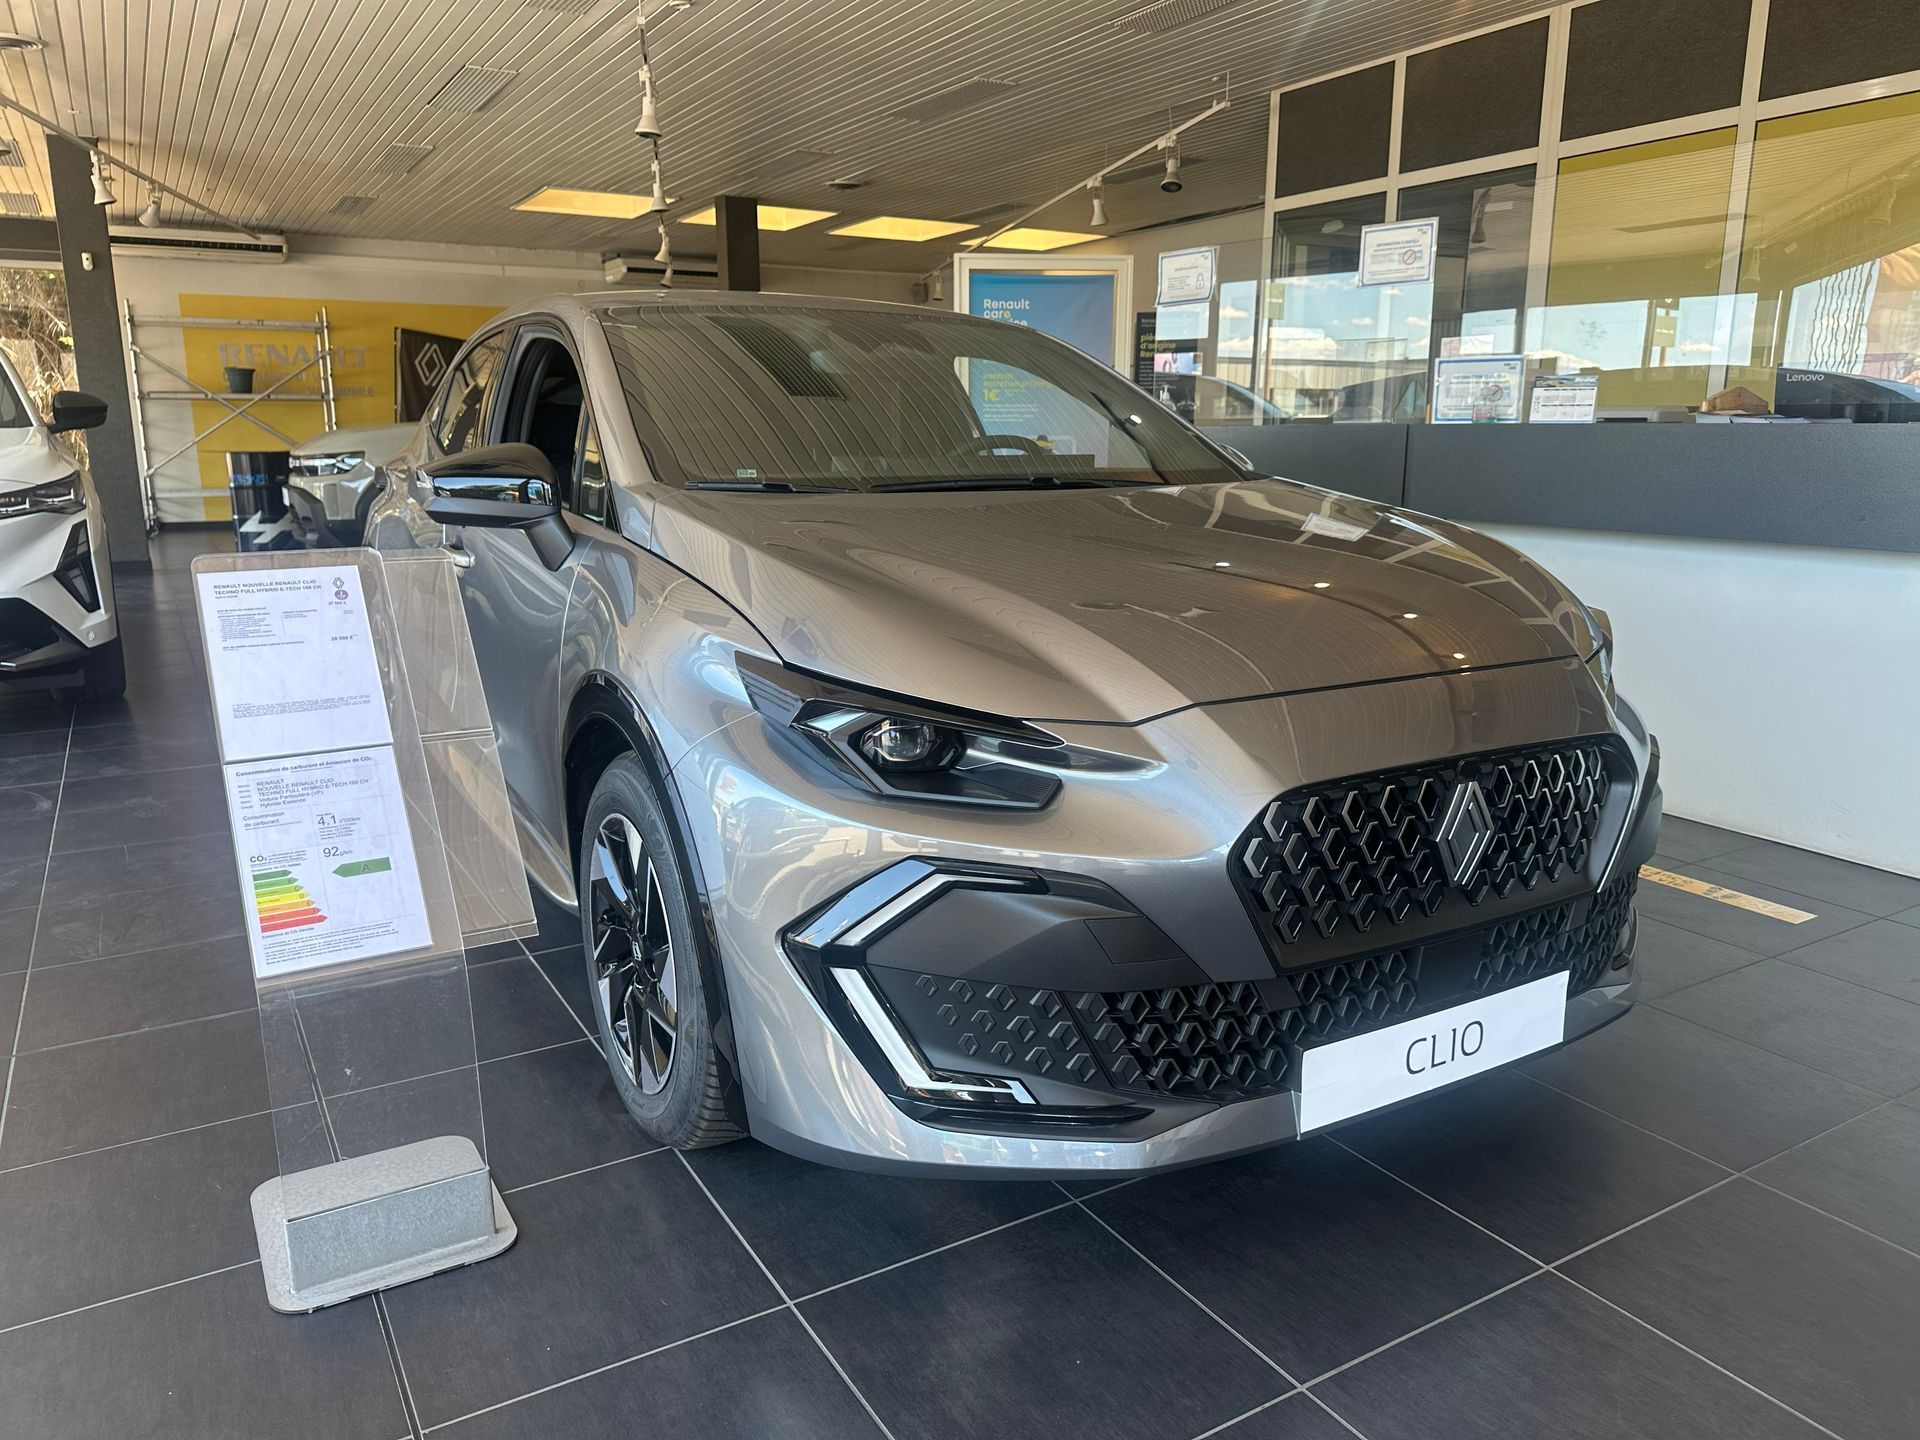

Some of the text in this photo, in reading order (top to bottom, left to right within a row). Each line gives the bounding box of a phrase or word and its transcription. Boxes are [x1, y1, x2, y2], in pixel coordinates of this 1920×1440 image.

[984, 299, 1030, 310] Renault
[984, 310, 1012, 319] care
[1786, 373, 1825, 382] Lenovo
[236, 768, 281, 777] Consommation
[290, 763, 318, 771] carburant
[258, 783, 290, 792] NOUVELLE
[291, 779, 319, 788] RENAULT
[285, 786, 301, 794] FULL
[301, 784, 324, 792] HYBRID
[243, 811, 285, 821] Consommation
[318, 815, 336, 826] 4.1
[252, 818, 280, 827] carburant
[323, 846, 339, 857] 92
[362, 863, 371, 873] A
[1406, 1020, 1484, 1075] CLIO
